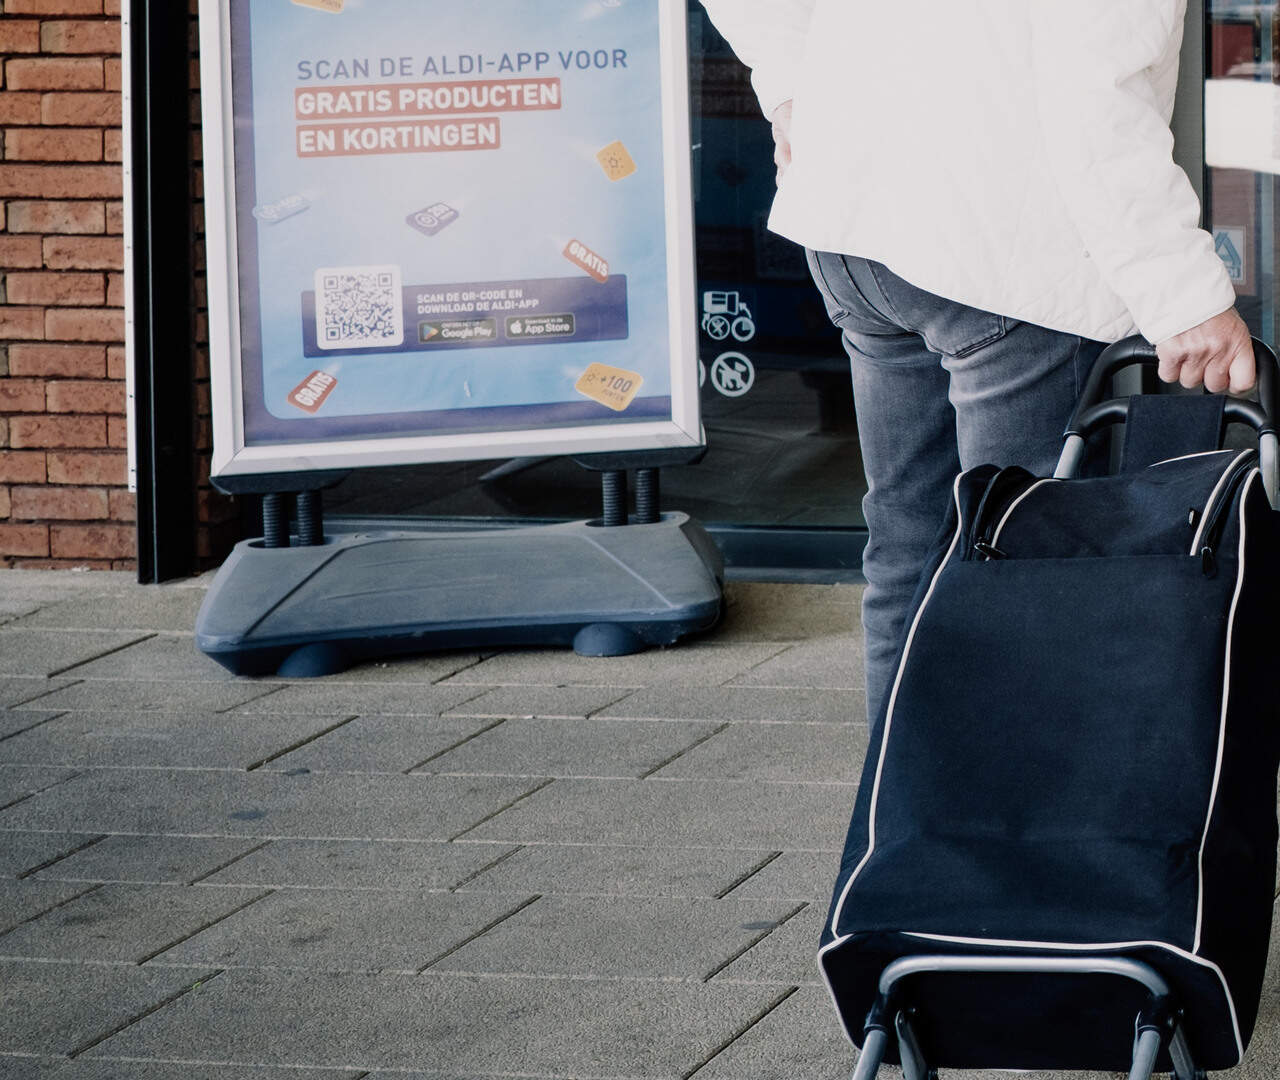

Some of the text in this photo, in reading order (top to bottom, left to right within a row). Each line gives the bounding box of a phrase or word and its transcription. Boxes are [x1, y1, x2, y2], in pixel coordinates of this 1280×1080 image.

[296, 48, 628, 81] SCAN DE ALDI-APP VOOR
[297, 83, 558, 115] GRATIS PRODUCTEN
[299, 122, 497, 153] EN KORTINGEN
[568, 241, 609, 278] GRATIS
[416, 288, 523, 304] SCAN DE QR-CODE EN
[416, 298, 540, 314] DOWNLOAD DE ALDI-APP
[441, 326, 492, 339] Google Play
[524, 321, 570, 335] App Store
[294, 371, 334, 407] GRATIS
[600, 374, 633, 393] +100
